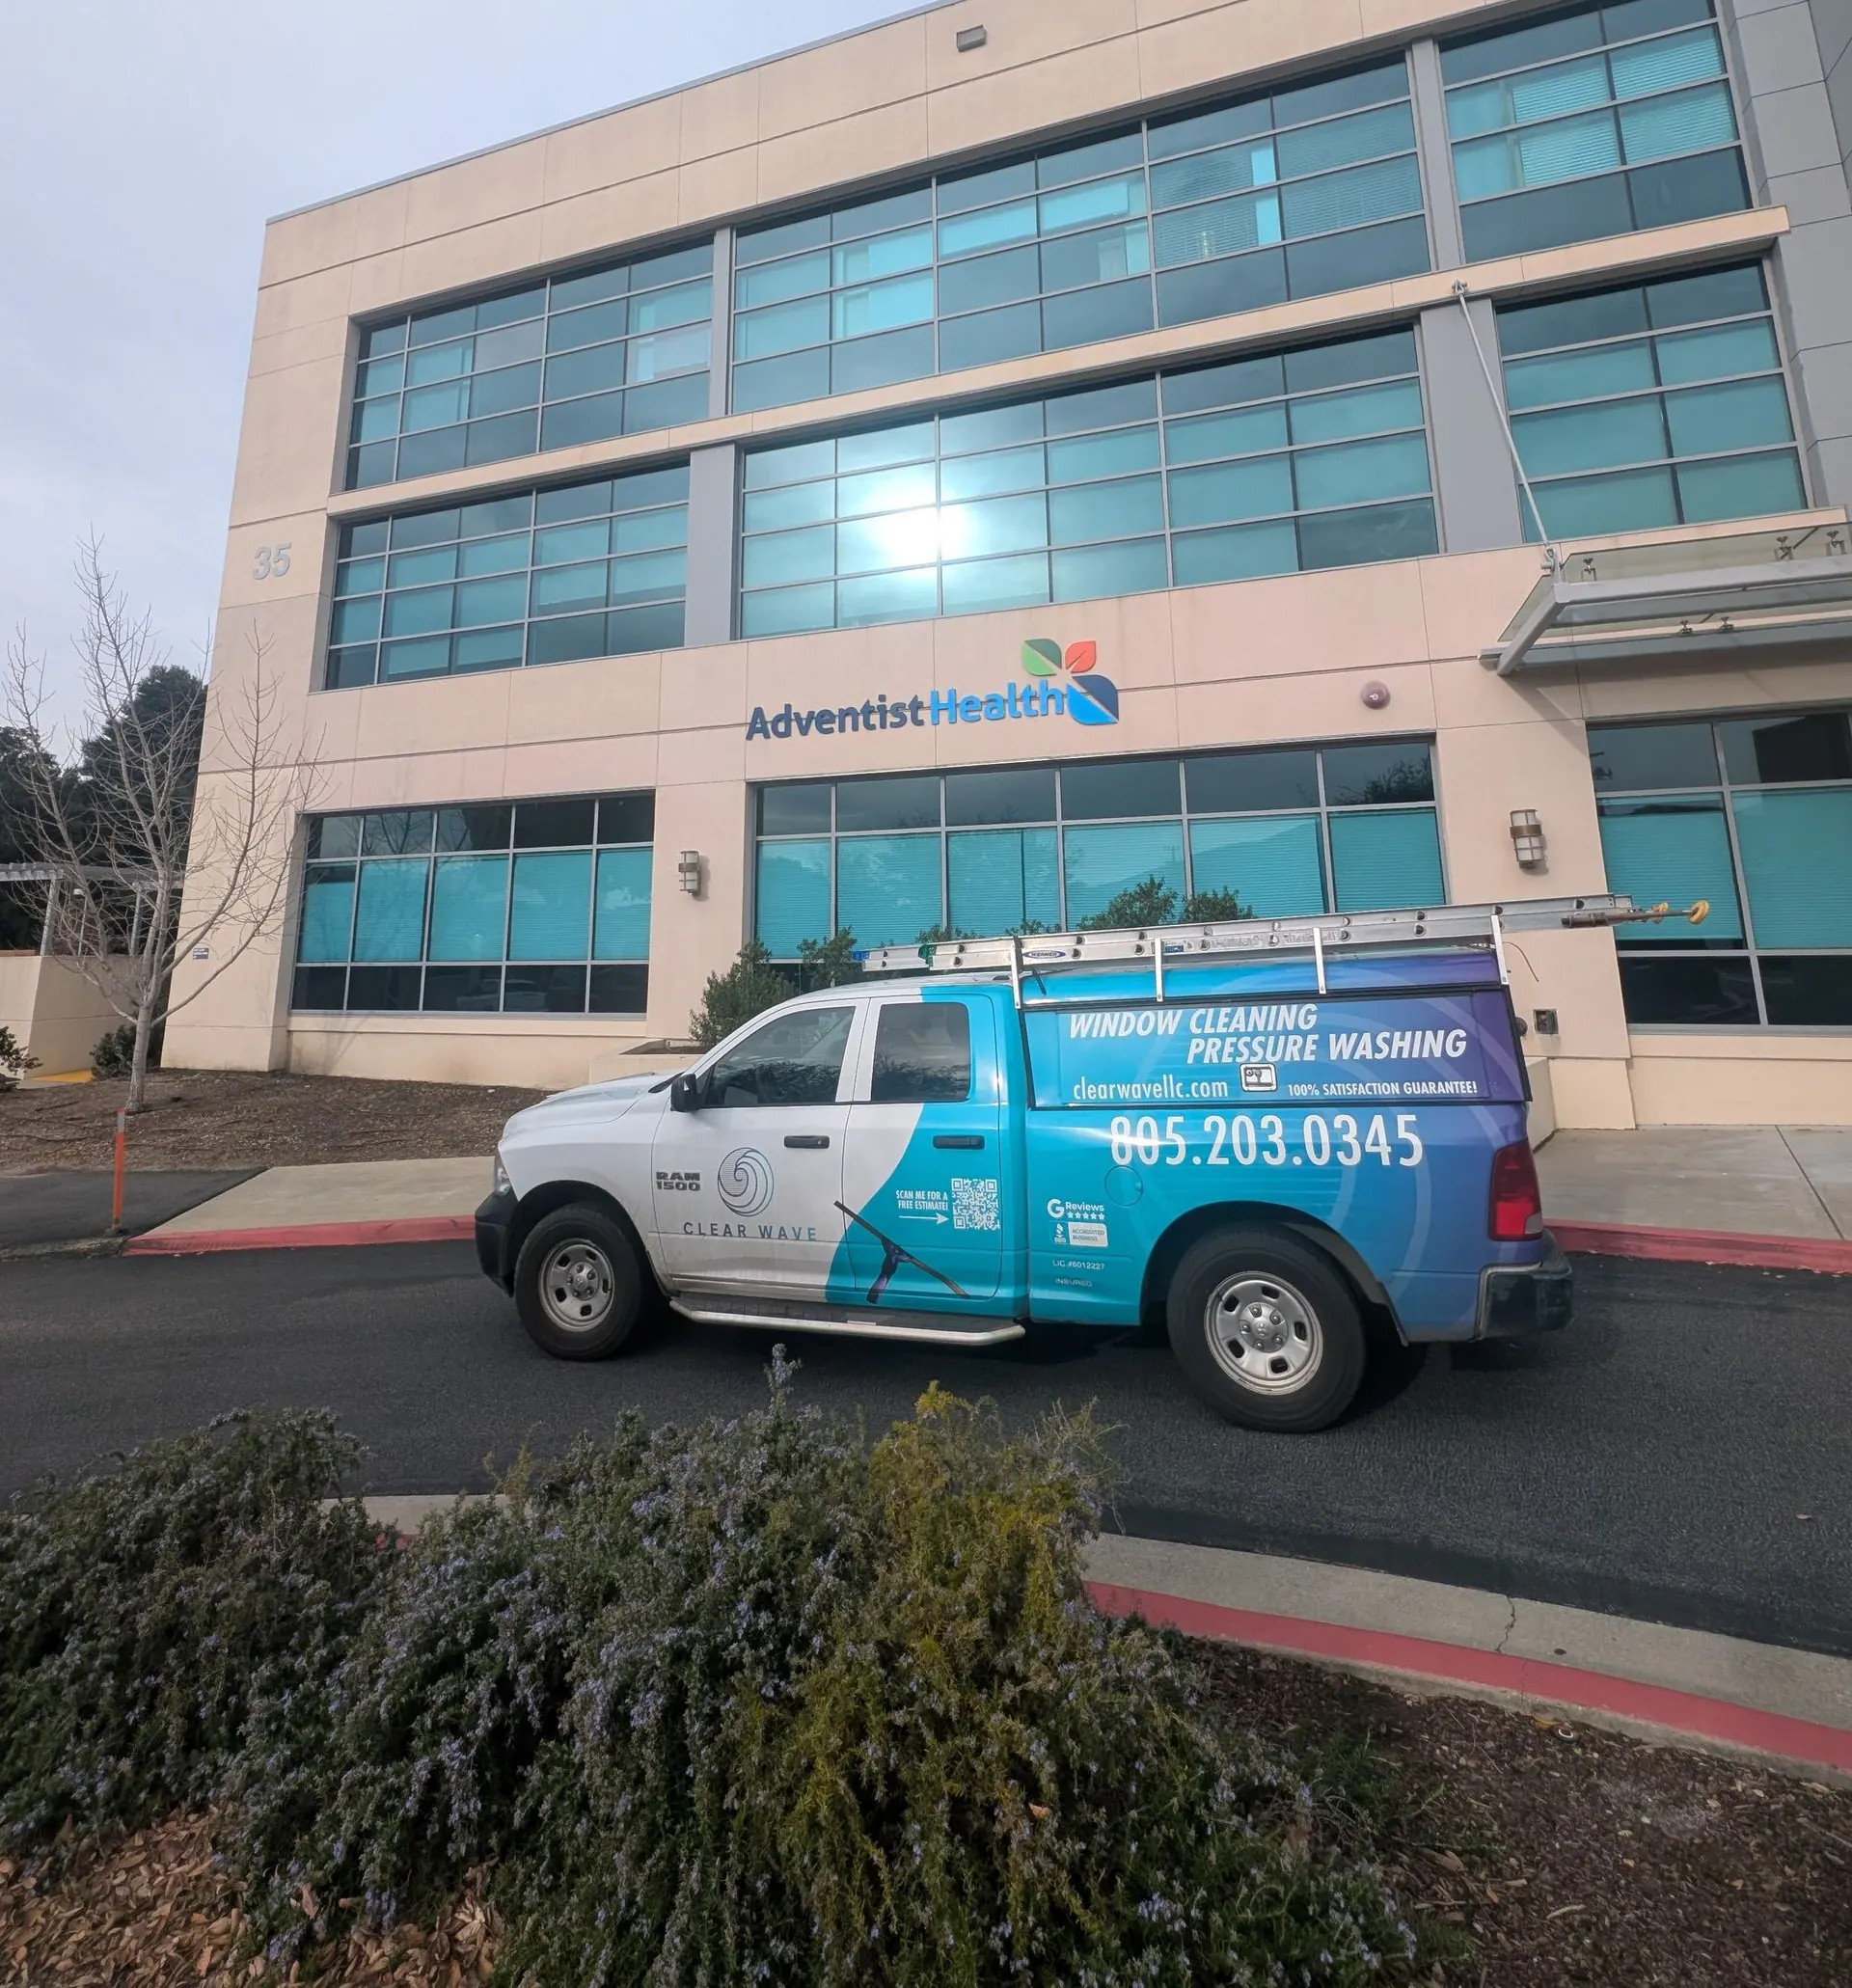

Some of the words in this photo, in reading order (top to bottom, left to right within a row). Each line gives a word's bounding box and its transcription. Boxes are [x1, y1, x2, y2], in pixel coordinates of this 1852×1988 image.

[253, 543, 291, 580] 35
[1070, 1010, 1183, 1039] WINDOW
[1188, 1004, 1318, 1035] CLEANING
[1186, 1034, 1319, 1064] PRESSURE
[1328, 1029, 1467, 1060] WASHING
[1073, 1074, 1228, 1100] clearwavellc.com
[1288, 1084, 1320, 1097] 100%
[1322, 1081, 1400, 1096] SATISFACTION
[1403, 1080, 1478, 1094] GUARANTEE!
[1110, 1114, 1424, 1166] 805.203.0345
[656, 1172, 700, 1182] RAM
[656, 1182, 700, 1191] 1500
[896, 1190, 913, 1200] SCAN
[915, 1191, 925, 1200] ME
[927, 1191, 941, 1200] FOR
[898, 1200, 913, 1210] FREE
[915, 1200, 948, 1211] ESTIMATE!
[1065, 1201, 1104, 1212] Reviews
[683, 1222, 748, 1238] CLEAR
[758, 1225, 817, 1241] WAVE
